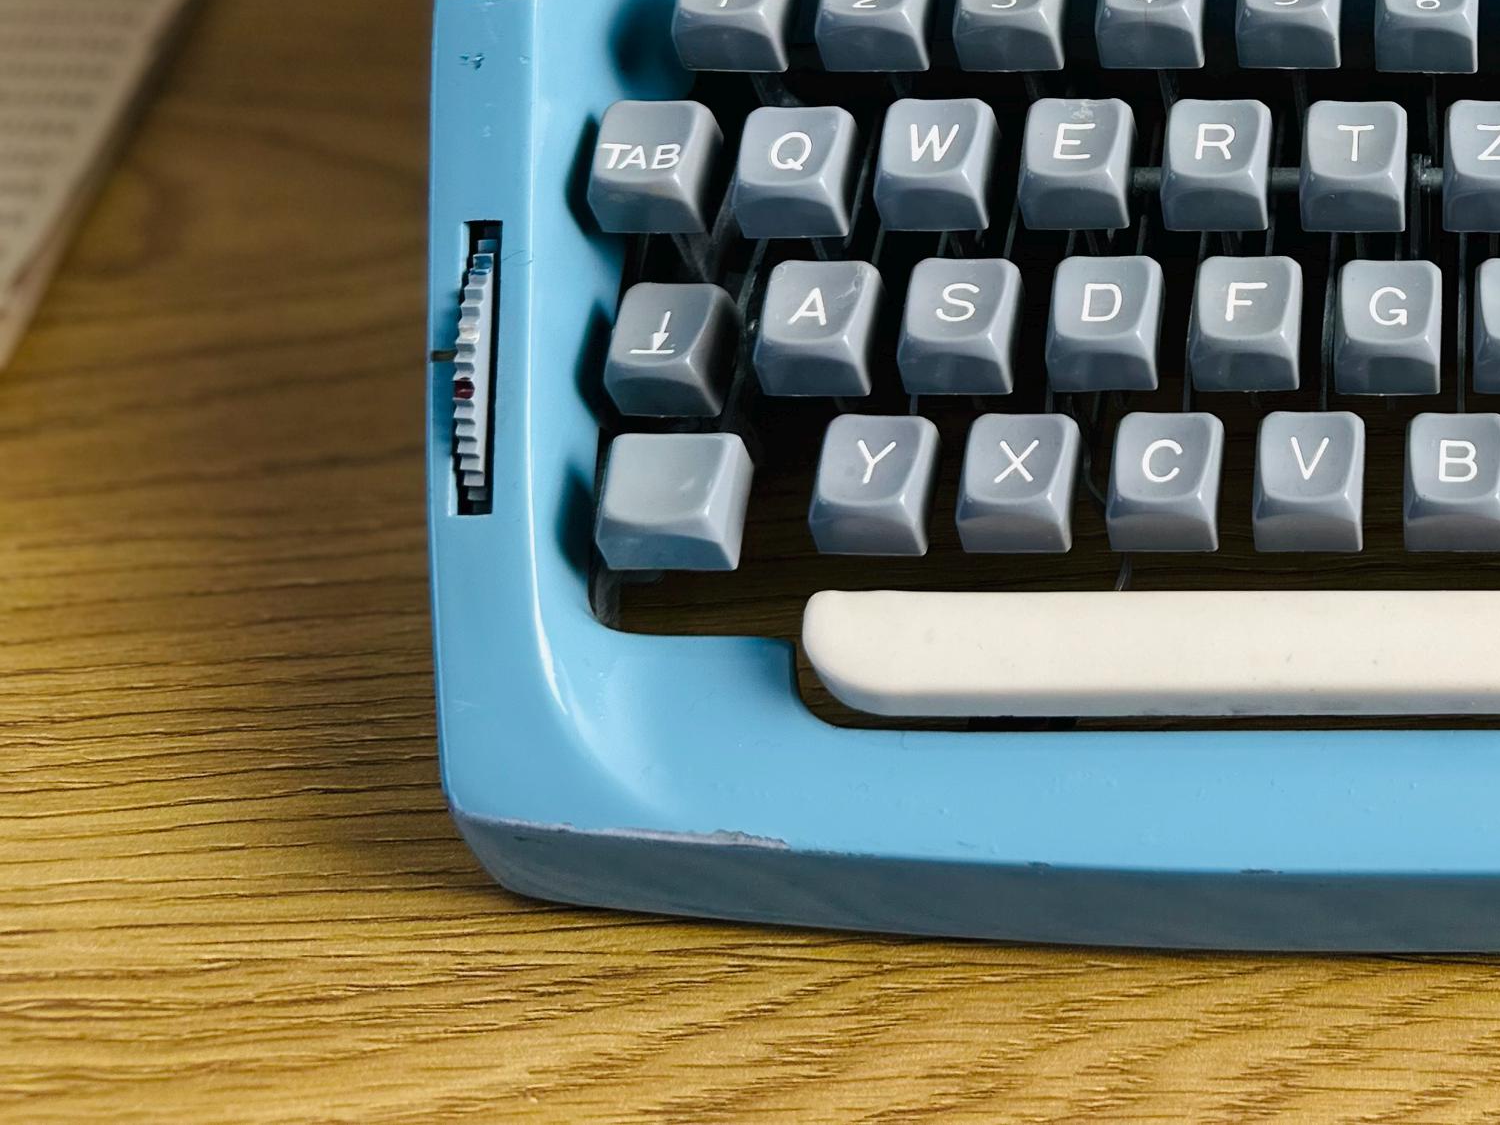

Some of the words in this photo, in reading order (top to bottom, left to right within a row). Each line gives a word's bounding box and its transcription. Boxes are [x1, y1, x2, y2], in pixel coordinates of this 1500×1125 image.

[600, 143, 681, 170] TAB
[770, 132, 812, 171] Q
[909, 124, 959, 162] W
[1053, 123, 1096, 160] E
[1195, 124, 1236, 160] R
[1337, 125, 1374, 162] T
[787, 288, 827, 326] A
[935, 283, 980, 322] S
[1081, 283, 1122, 322] D
[1225, 282, 1268, 321] F
[1369, 287, 1408, 326] G
[858, 439, 896, 484] Y
[994, 439, 1039, 484] X
[1141, 439, 1183, 482] C
[1290, 436, 1329, 480] V
[1438, 439, 1478, 482] B
